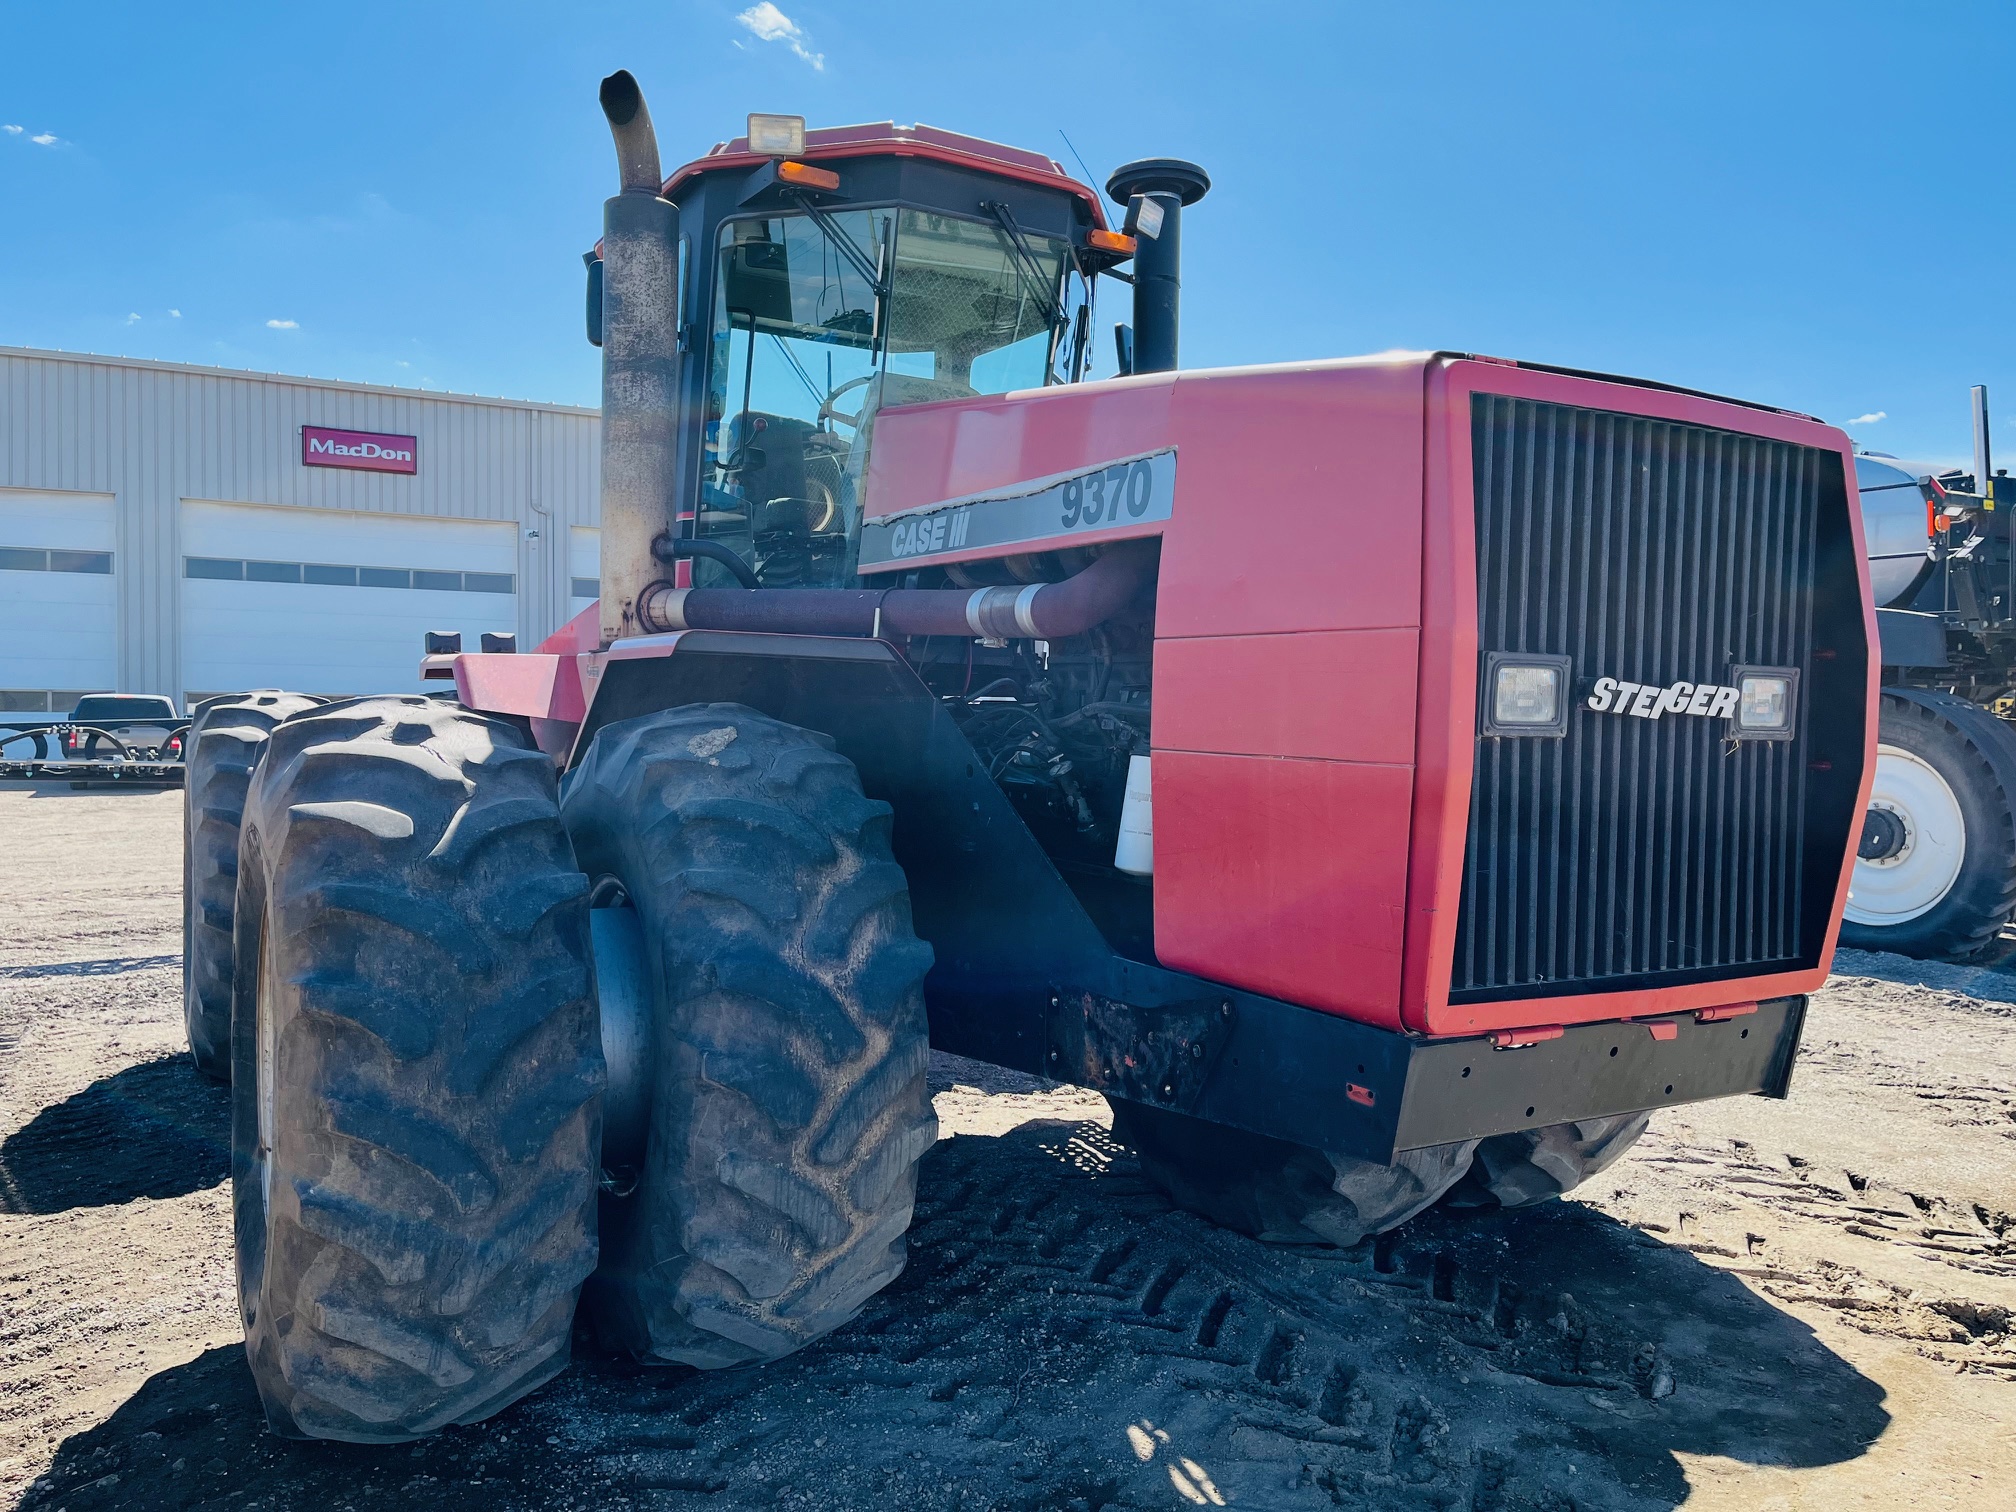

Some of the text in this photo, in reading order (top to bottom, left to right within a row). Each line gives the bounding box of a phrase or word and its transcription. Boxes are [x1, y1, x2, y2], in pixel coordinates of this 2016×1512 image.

[309, 438, 411, 461] MacDon
[1061, 459, 1152, 529] 9370
[891, 515, 948, 557] CASE
[1588, 677, 1740, 720] STEIGER
